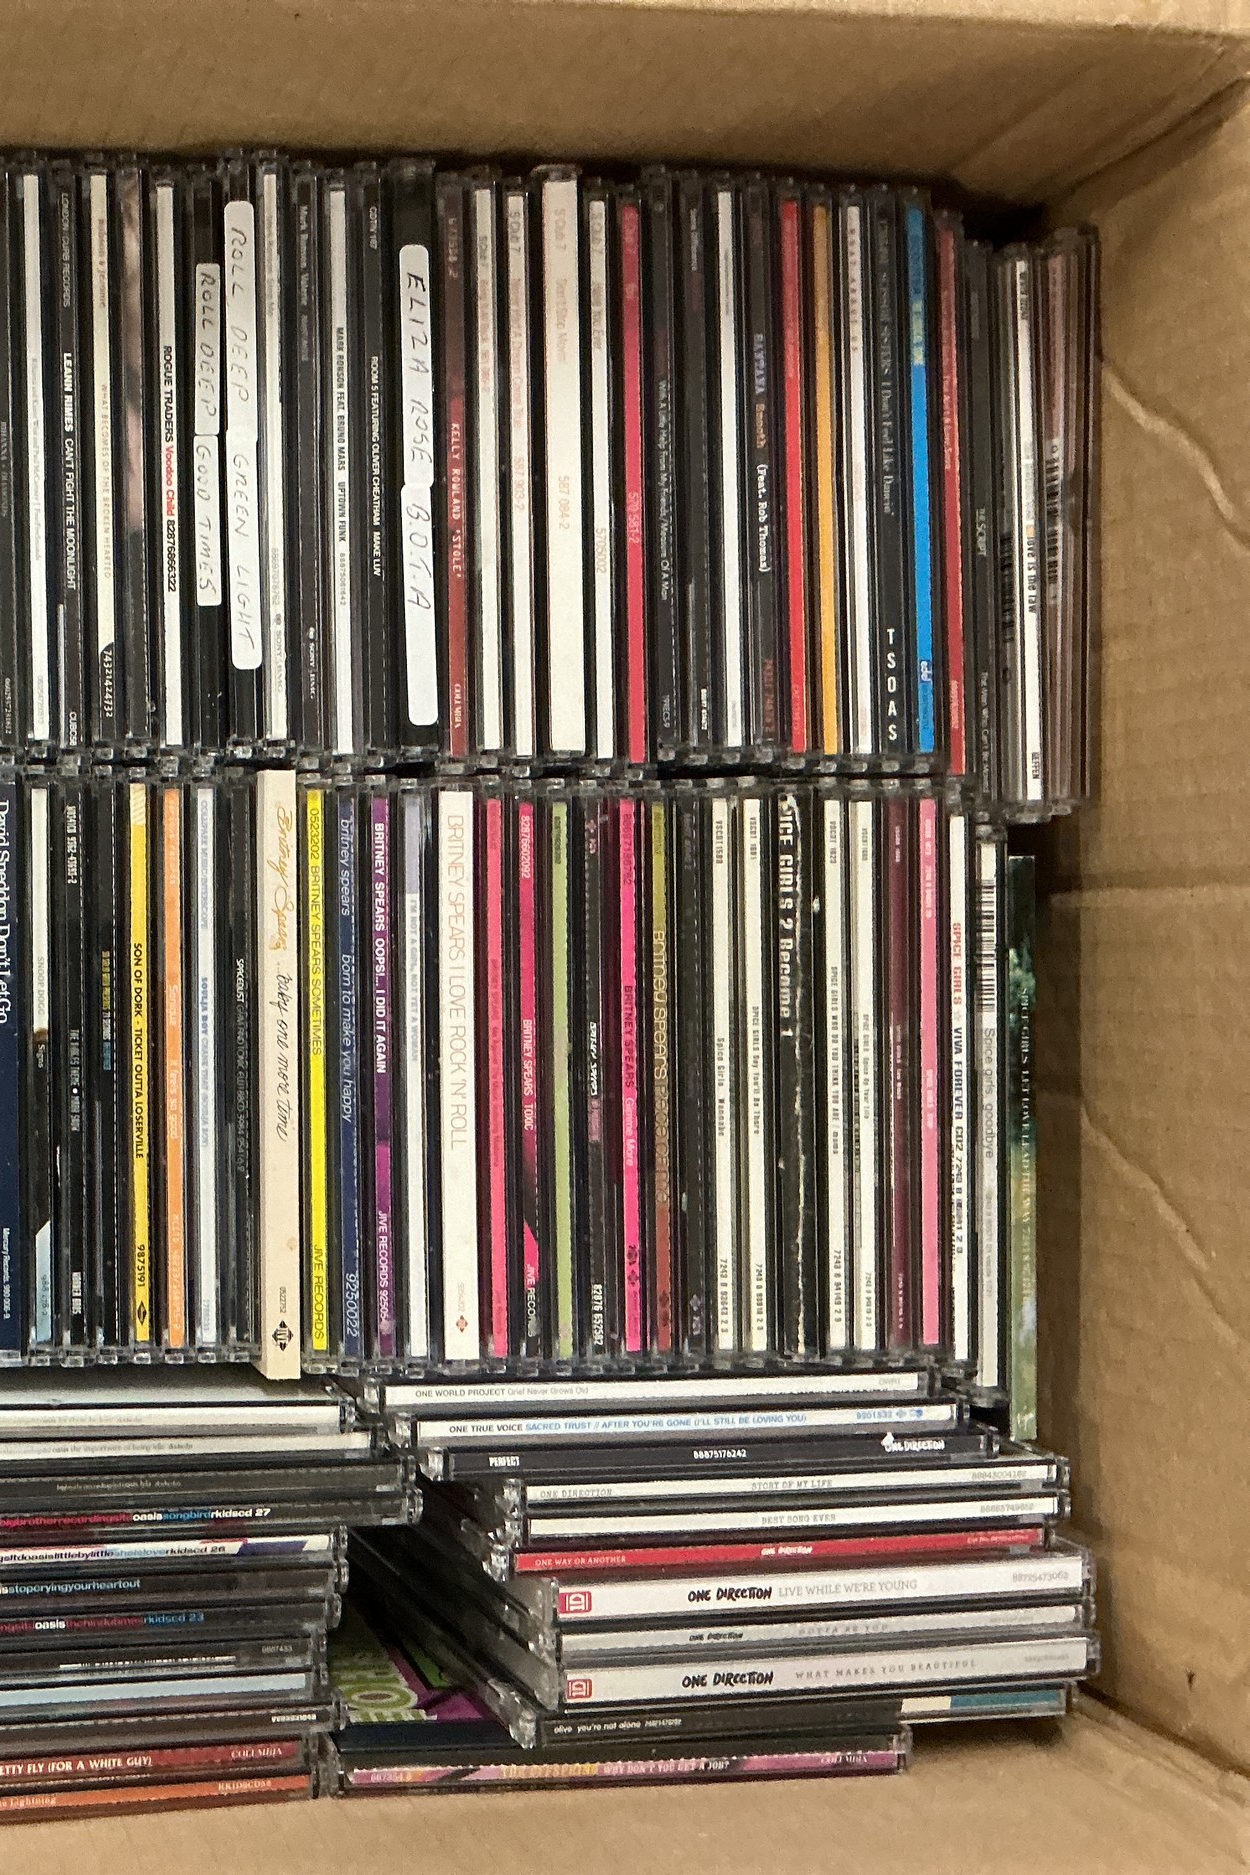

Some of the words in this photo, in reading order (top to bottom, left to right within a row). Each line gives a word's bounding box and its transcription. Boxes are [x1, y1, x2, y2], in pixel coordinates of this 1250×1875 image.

[229, 227, 248, 296] ROLL
[199, 271, 215, 328] ROLL
[405, 273, 428, 373] ELIZA
[63, 353, 73, 392] LEANN
[163, 345, 173, 384] ROGUE
[199, 343, 217, 416] DEEP
[231, 326, 249, 403] DEEP
[370, 356, 379, 381] ROOM
[64, 396, 74, 431] RIMES
[164, 388, 174, 442] TRADERS
[371, 393, 380, 441] FEATURING
[410, 398, 432, 463] ROSE
[371, 444, 380, 473] OLIVER
[451, 423, 460, 459] KELLY
[65, 471, 75, 499] FIGHT
[165, 445, 175, 485] Voodoo
[196, 444, 213, 501] GOOD
[65, 503, 75, 524] THE
[166, 489, 176, 516] Child
[232, 454, 251, 536] GREEN
[372, 476, 381, 525] CHEATHAM
[452, 467, 461, 520] ROWLAND
[66, 528, 76, 589] MOONLIGHT
[167, 520, 177, 592] 82876866322
[199, 518, 215, 593] TIMES
[372, 532, 381, 556] MAKE
[236, 565, 256, 649] LIGHT
[102, 650, 114, 717] 74321424732
[309, 808, 320, 859] 0523202
[339, 819, 352, 866] britney
[374, 823, 385, 876] BRITNEY
[447, 815, 465, 886] BRITNEY
[309, 865, 321, 919] BRITNEY
[339, 870, 353, 916] spears
[375, 881, 386, 931] SPEARS
[448, 892, 466, 960] SPEARS
[952, 923, 962, 960] SPICE
[133, 943, 143, 964] SON
[310, 924, 322, 975] SPEARS
[339, 954, 353, 983] born
[133, 969, 144, 981] OF
[340, 987, 353, 999] to
[448, 975, 466, 1019] LOVE
[953, 967, 963, 1004] GIRLS
[133, 985, 144, 1015] DORK
[311, 979, 323, 1055] SOMETIMES
[375, 997, 386, 1014] DID
[134, 1028, 145, 1063] TICKET
[340, 1003, 354, 1046] make
[375, 1019, 386, 1031] IT
[953, 1027, 963, 1055] VIVA
[340, 1050, 354, 1076] you
[375, 1035, 386, 1073] AGAIN
[449, 1026, 467, 1073] ROCK
[134, 1066, 145, 1099] OUTTA
[340, 1079, 354, 1123] happy
[954, 1061, 963, 1120] FOREVER
[135, 1102, 146, 1158] LOSERVILLE
[450, 1104, 467, 1150] ROLL
[136, 1244, 147, 1287] 9875191
[314, 1245, 324, 1273] JIVE
[314, 1277, 325, 1340] RECORDS
[346, 1273, 358, 1336] 9250022
[450, 1425, 467, 1434] ONE
[471, 1424, 493, 1434] TRUE
[496, 1423, 523, 1433] VOICE
[688, 1589, 712, 1603] ONE
[716, 1586, 771, 1600] DIRECTION
[682, 1674, 707, 1689] ONE
[714, 1672, 773, 1686] DIRECTION
[28, 1762, 45, 1774] FLY
[48, 1760, 71, 1773] (FOR
[89, 1758, 122, 1770] WHITE
[126, 1756, 152, 1768] GUY)
